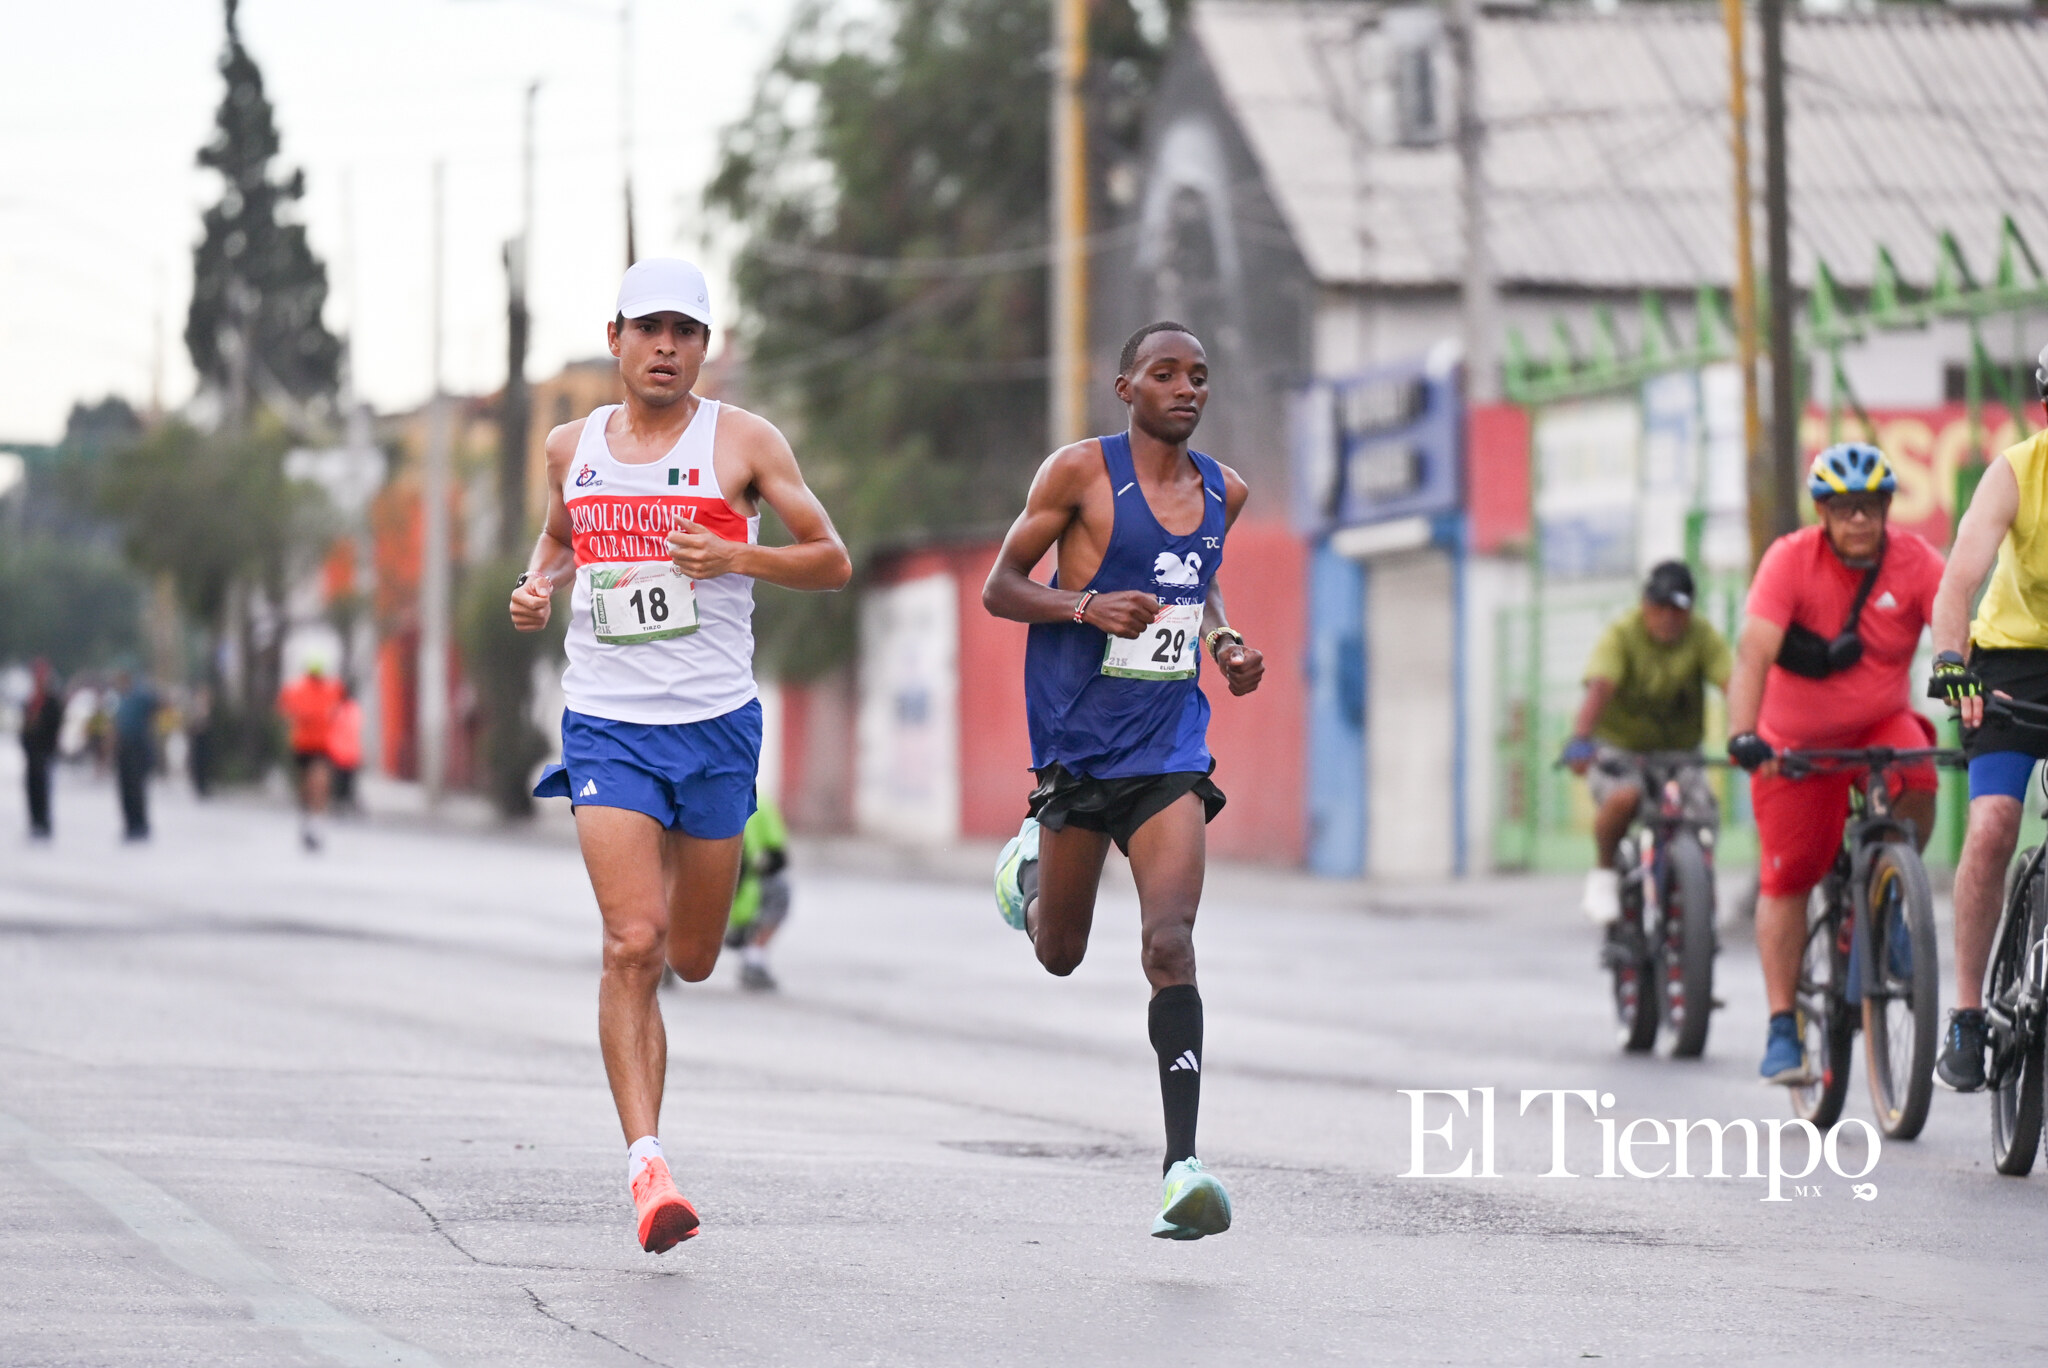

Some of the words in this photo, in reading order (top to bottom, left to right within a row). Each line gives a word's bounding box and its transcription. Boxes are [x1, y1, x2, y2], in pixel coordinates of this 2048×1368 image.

[571, 503, 634, 535] RODOLFO
[637, 498, 698, 532] GÓMEZ
[589, 535, 620, 559] CLUB
[629, 587, 669, 624] 18
[642, 624, 662, 632] TIRZO
[1151, 628, 1185, 663] 29
